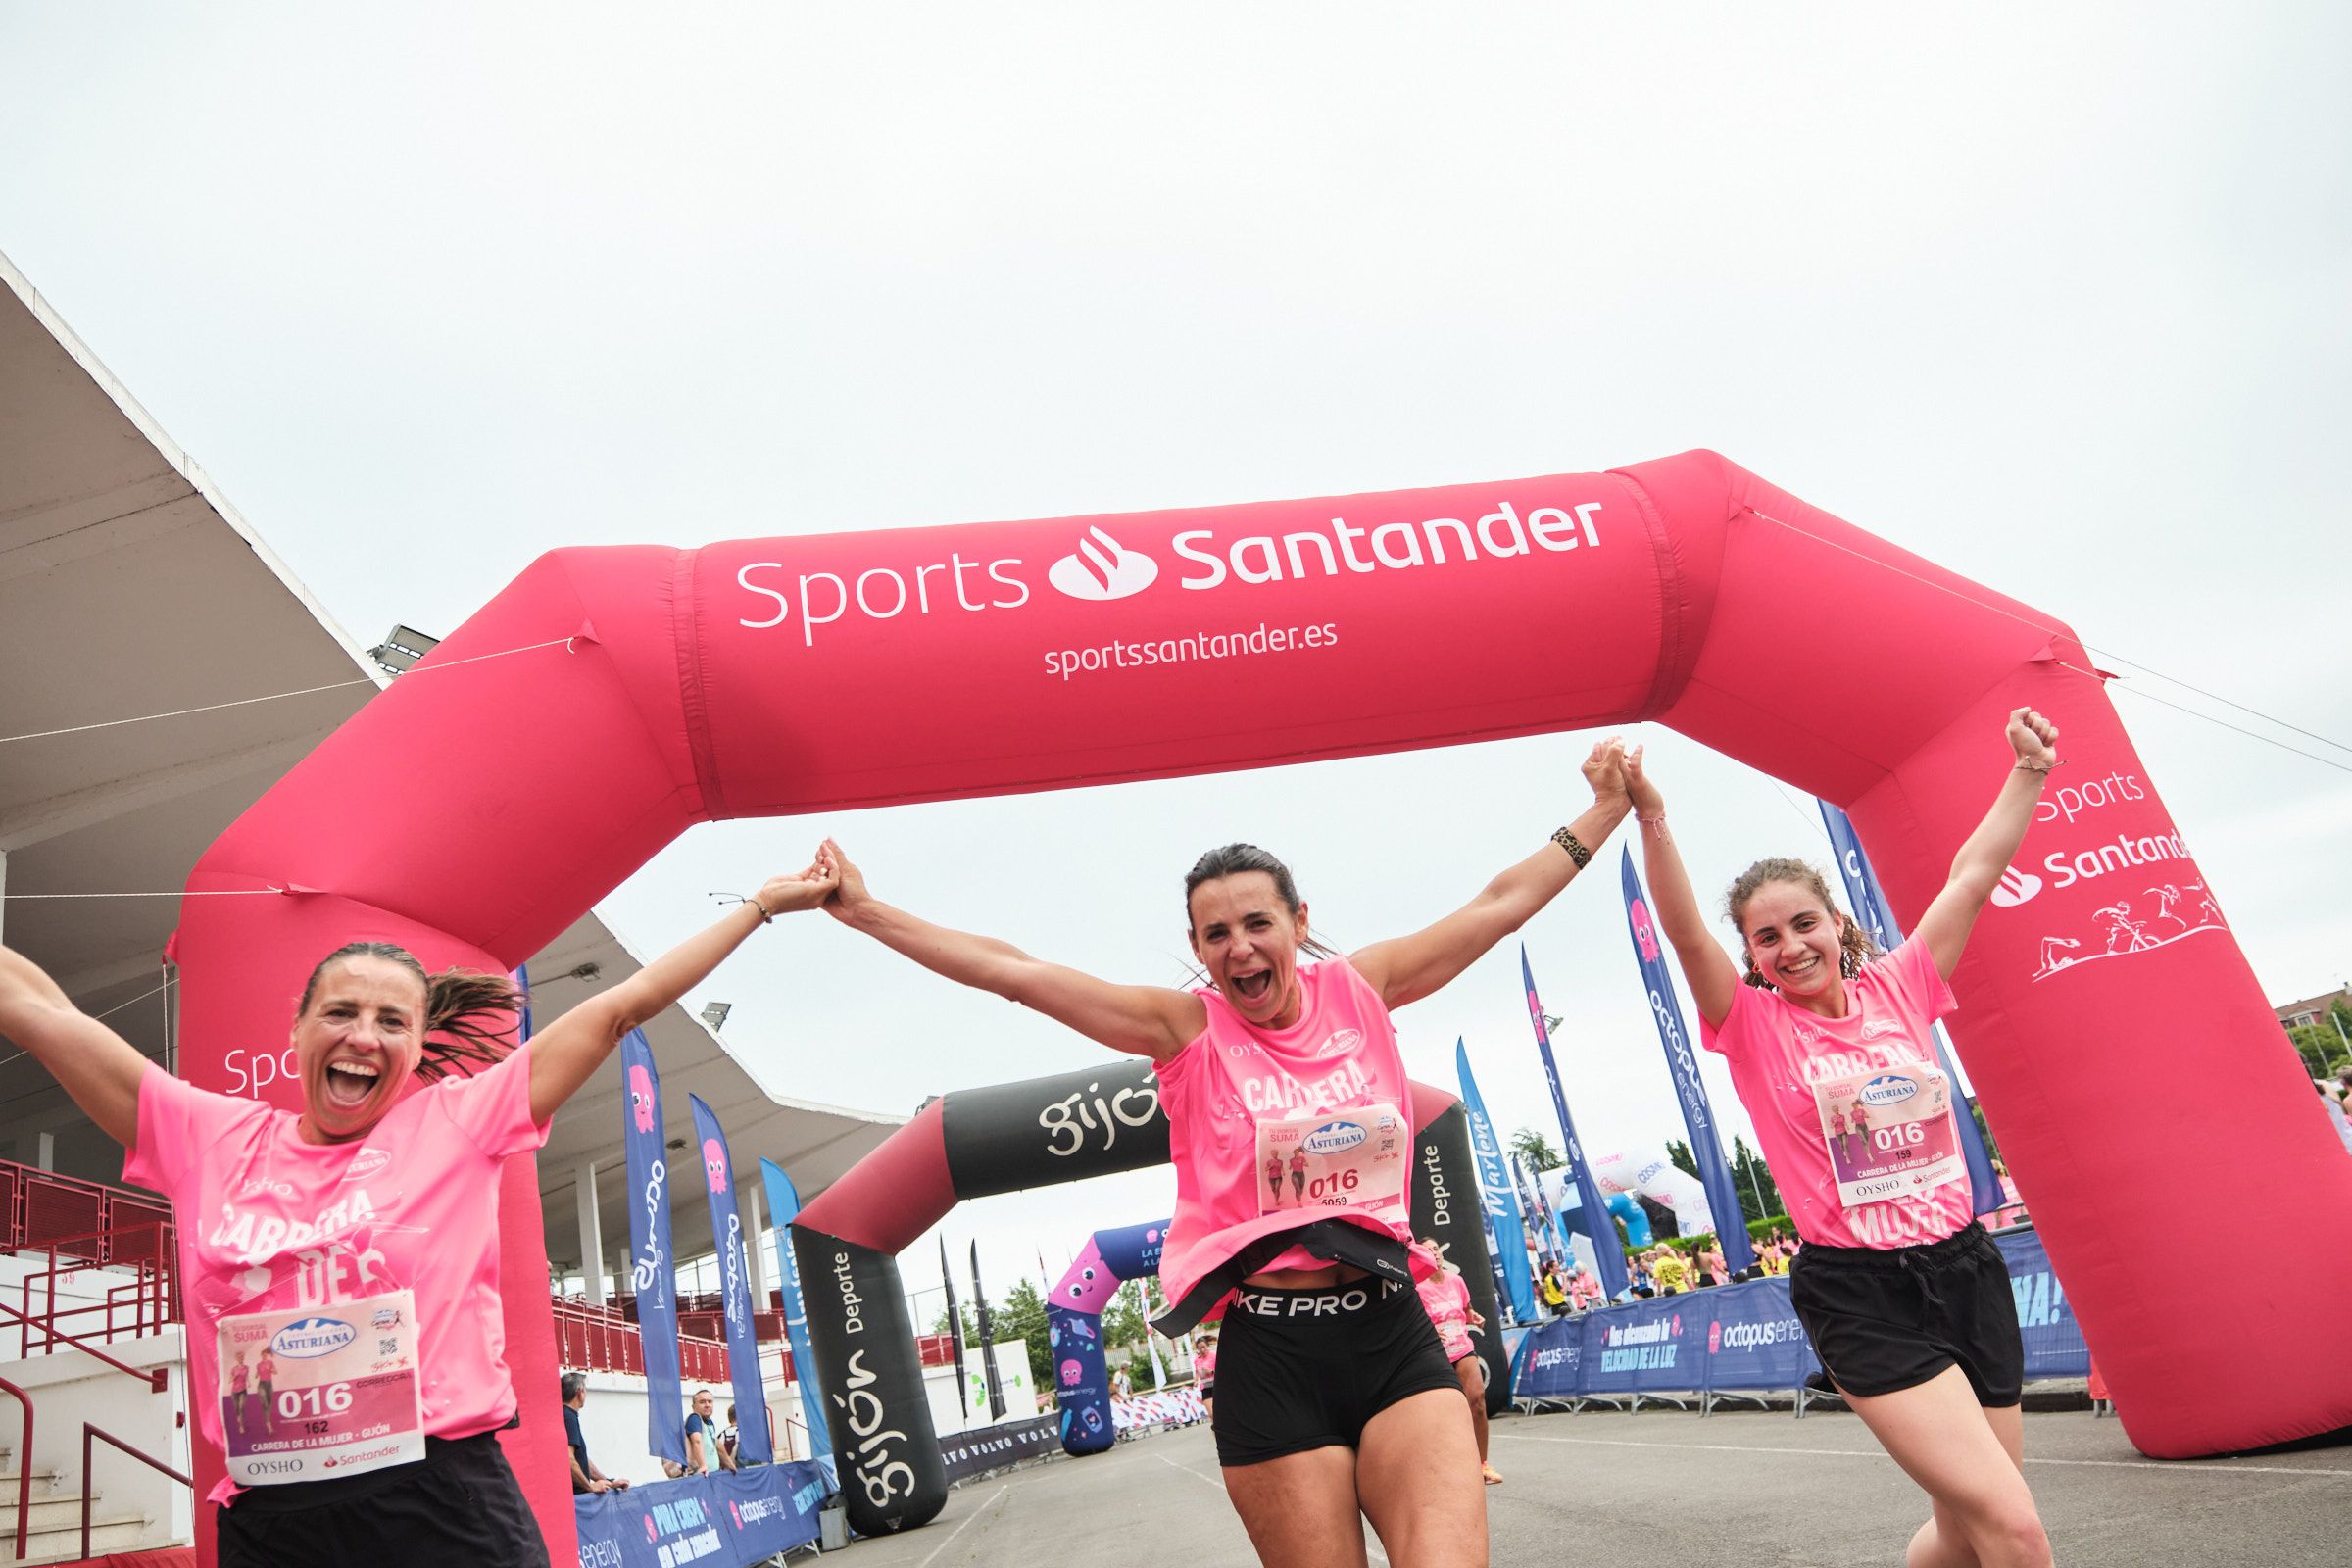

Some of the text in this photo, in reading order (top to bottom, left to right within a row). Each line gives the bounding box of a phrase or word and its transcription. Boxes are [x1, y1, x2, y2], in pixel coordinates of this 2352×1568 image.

[736, 501, 1604, 647] Sports Santander
[1044, 621, 1339, 682] sportssantander.es
[2043, 828, 2191, 889] Santand
[1230, 1043, 1265, 1059] OYS
[1828, 1088, 1855, 1100] SUMA
[1864, 1086, 1915, 1102] ASTURIANA
[1269, 1133, 1299, 1143] SUMA
[1308, 1133, 1362, 1150] ASTURIANA
[1874, 1122, 1925, 1151] 016
[1473, 1110, 1513, 1218] Marlene
[1895, 1150, 1912, 1160] 159
[1857, 1167, 1889, 1179] CARRERA
[1898, 1162, 1907, 1171] LA
[1907, 1157, 1929, 1168] MUJER
[1309, 1168, 1359, 1200] 016
[1424, 1144, 1451, 1226] Deporte
[1856, 1179, 1900, 1197] OYSHO
[835, 1252, 864, 1335] Deporte
[1288, 1290, 1368, 1317] PRO
[234, 1330, 268, 1343] SUMA
[277, 1331, 350, 1352] ASTURIANA
[278, 1381, 353, 1419] 016
[251, 1423, 390, 1452] CARRERA DE LA MUJER GIJÓN
[305, 1421, 329, 1435] 162
[833, 1348, 916, 1508] gijón
[340, 1444, 401, 1466] Santander
[969, 1437, 1013, 1457] VOLVO
[247, 1459, 303, 1476] OYSHO
